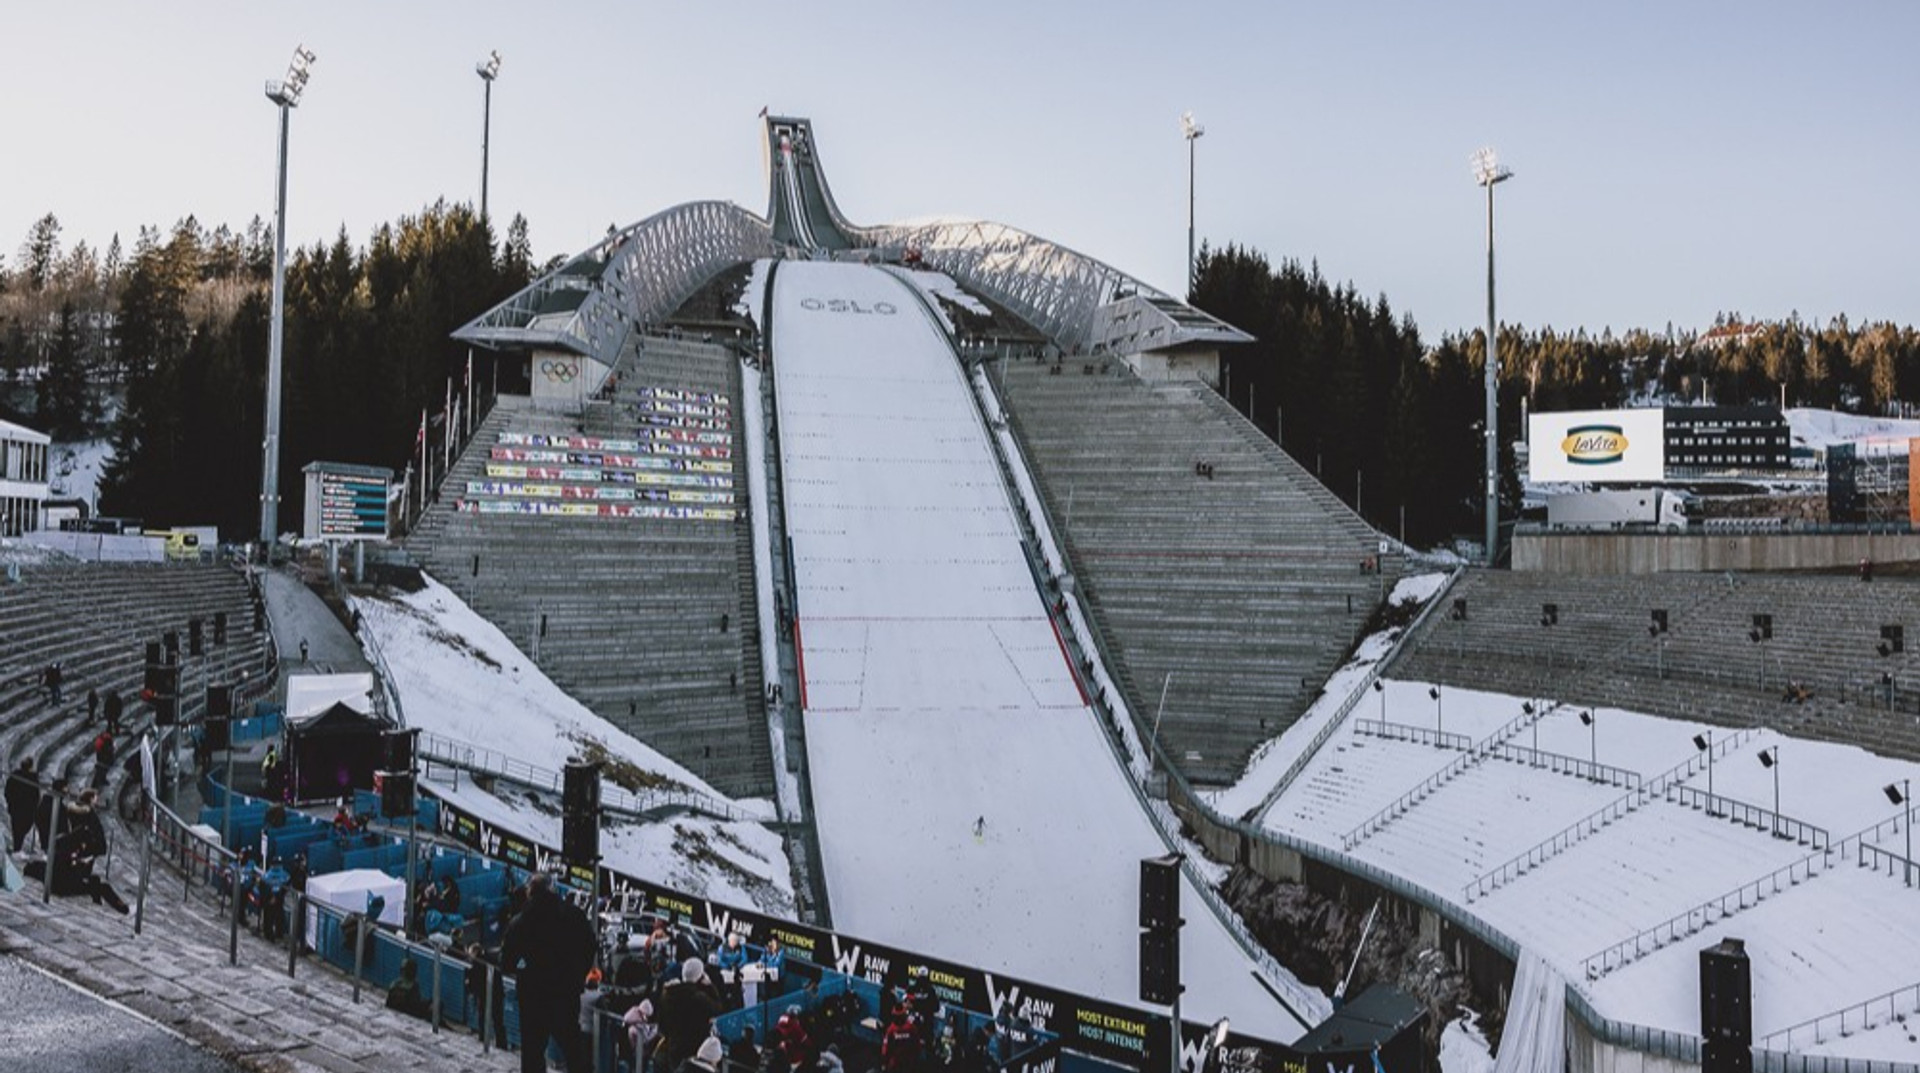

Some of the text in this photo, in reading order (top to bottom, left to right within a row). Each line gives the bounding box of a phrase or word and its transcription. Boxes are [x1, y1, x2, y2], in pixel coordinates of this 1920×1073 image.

[801, 298, 897, 315] OSLO
[705, 900, 730, 937] W
[831, 934, 861, 984] W
[864, 954, 890, 974] RAW
[864, 972, 882, 984] AIR
[929, 971, 965, 990] EXTREME
[1022, 996, 1055, 1018] RAW
[1077, 1008, 1147, 1037] MOST EXTREME
[1079, 1024, 1144, 1053] MOST INTENSE
